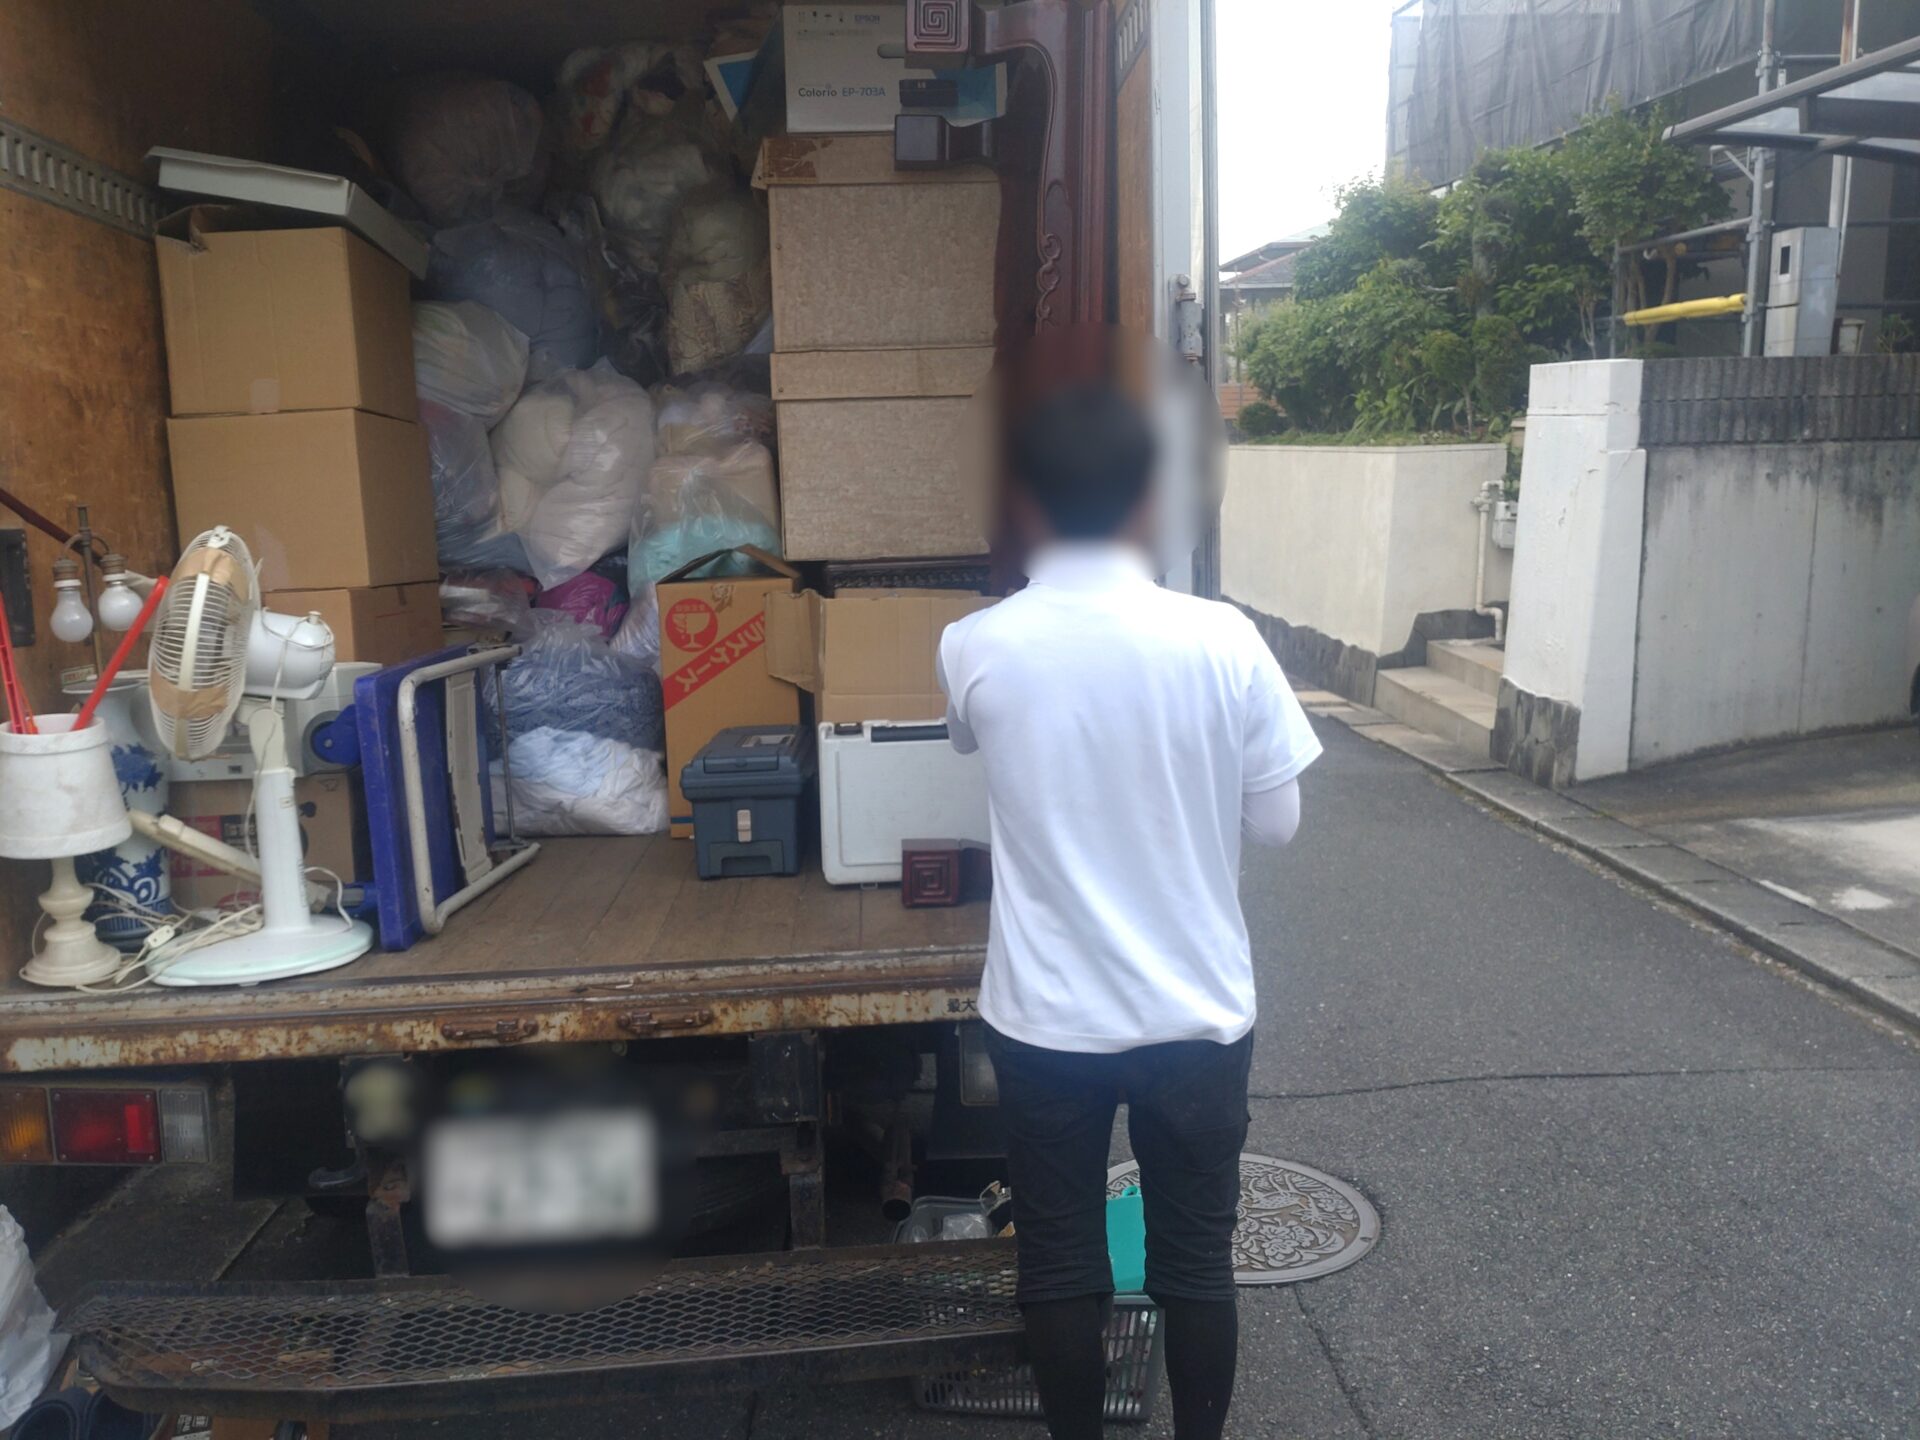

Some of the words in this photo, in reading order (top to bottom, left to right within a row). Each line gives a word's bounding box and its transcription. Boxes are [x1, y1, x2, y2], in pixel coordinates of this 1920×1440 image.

[798, 87, 838, 98] Colorio
[842, 87, 886, 97] EP-703A
[674, 613, 764, 693] ラスケース
[947, 998, 976, 1013] 最大
